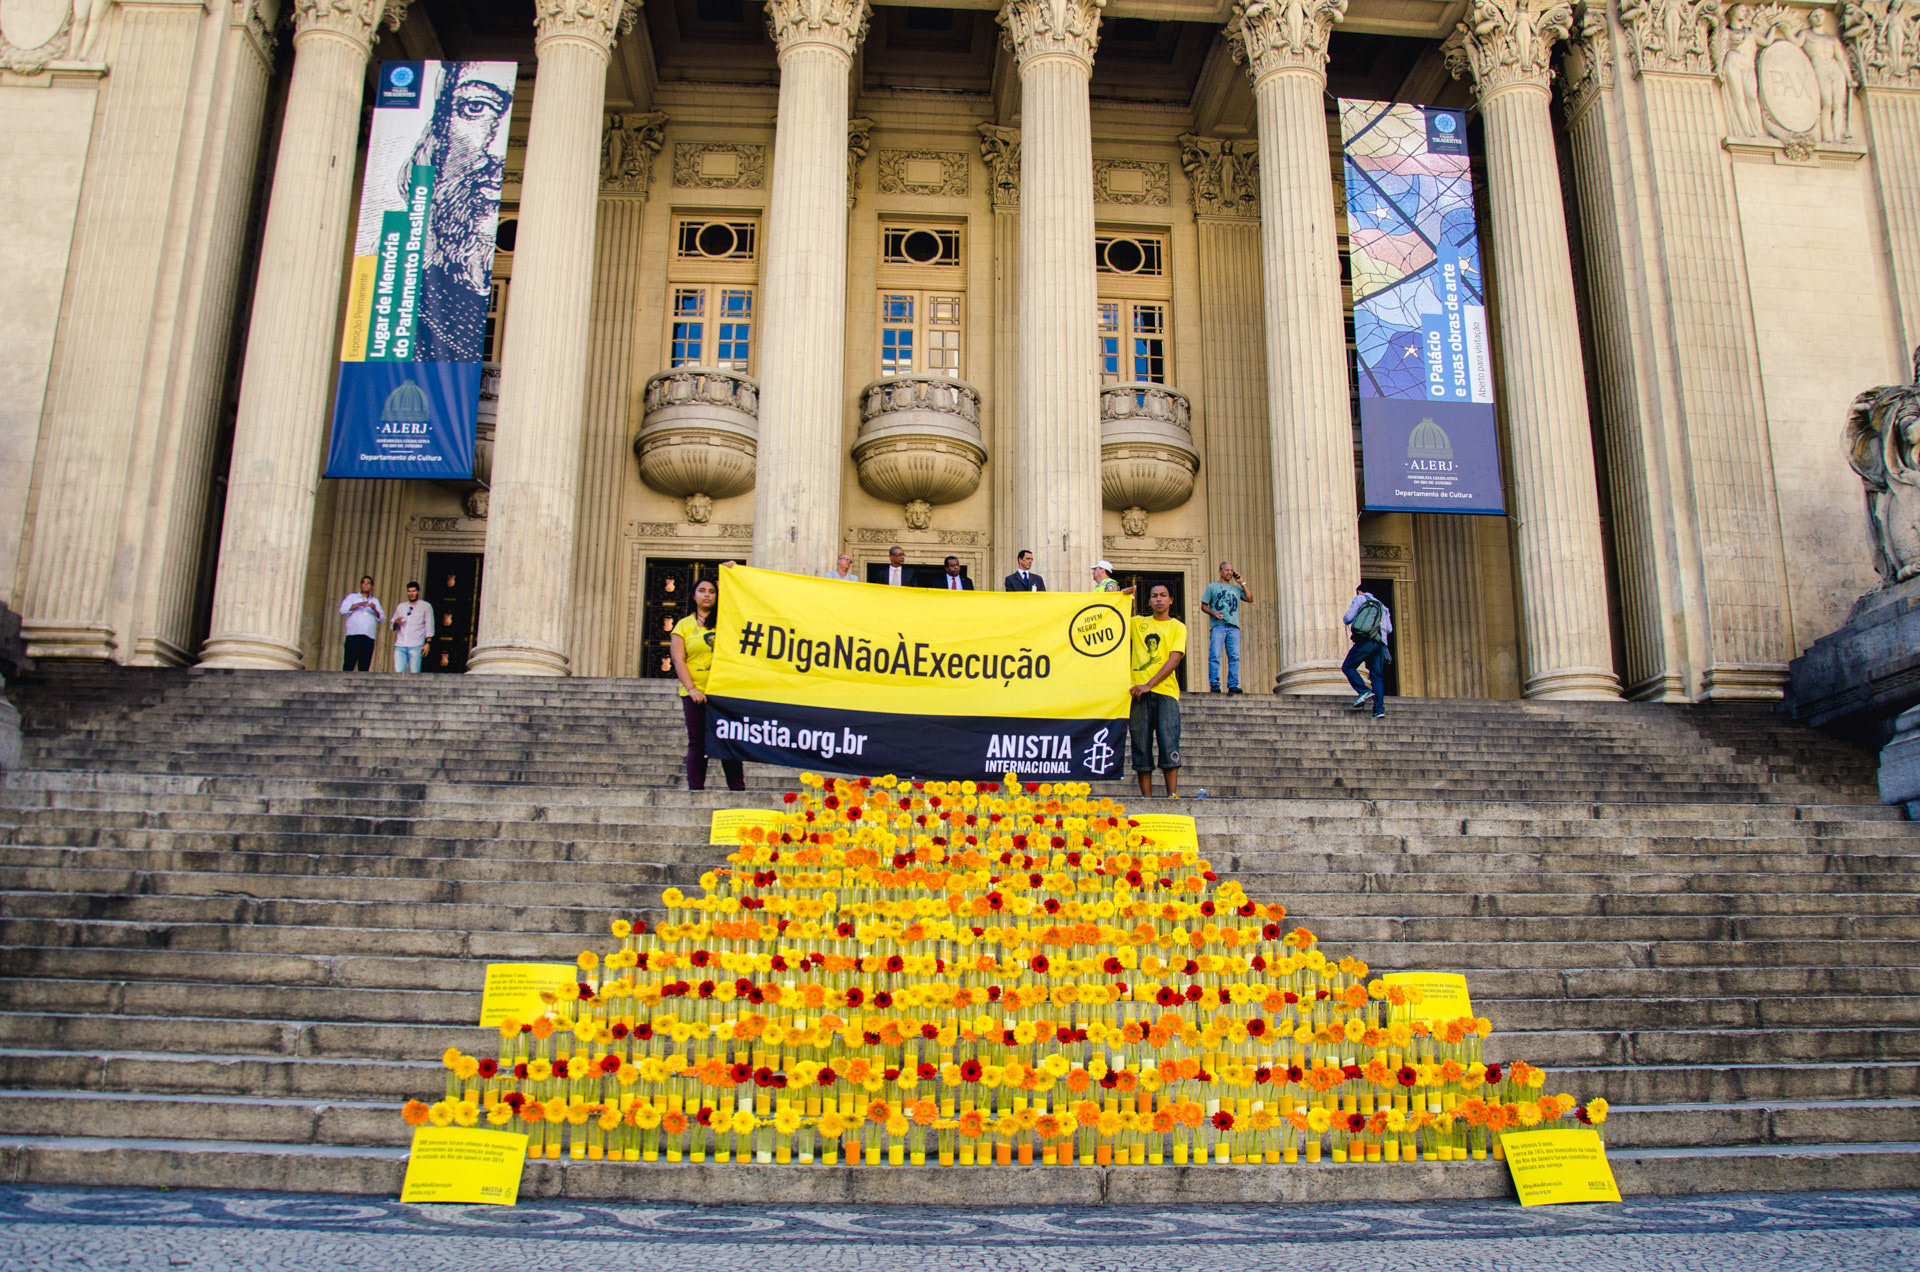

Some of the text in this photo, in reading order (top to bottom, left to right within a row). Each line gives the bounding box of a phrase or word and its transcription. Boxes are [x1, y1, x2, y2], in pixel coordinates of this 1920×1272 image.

[1769, 71, 1811, 99] PAX
[393, 185, 428, 358] do Parlamento Brasileiro
[370, 232, 400, 357] Lugar de Memória
[350, 273, 368, 358] Exposição Permanente
[1443, 263, 1467, 397] e suas obras de arte
[1427, 331, 1445, 396] O Palácio
[1473, 321, 1487, 398] Aberto para visitação
[381, 422, 428, 434] ALERJ
[360, 453, 407, 462] Departamento
[417, 454, 442, 462] Cultura
[1410, 460, 1453, 471] ALERJ
[1395, 489, 1439, 498] Departamento
[1077, 623, 1097, 633] NEGRO
[1084, 613, 1103, 623] JOVEM
[1083, 628, 1114, 646] VIVO
[739, 621, 1051, 688] #DigaNãoÀExecução
[716, 716, 868, 759] anistia.org.br
[986, 734, 1072, 759] ANISTIA
[985, 760, 1071, 774] INTERNACIONAL
